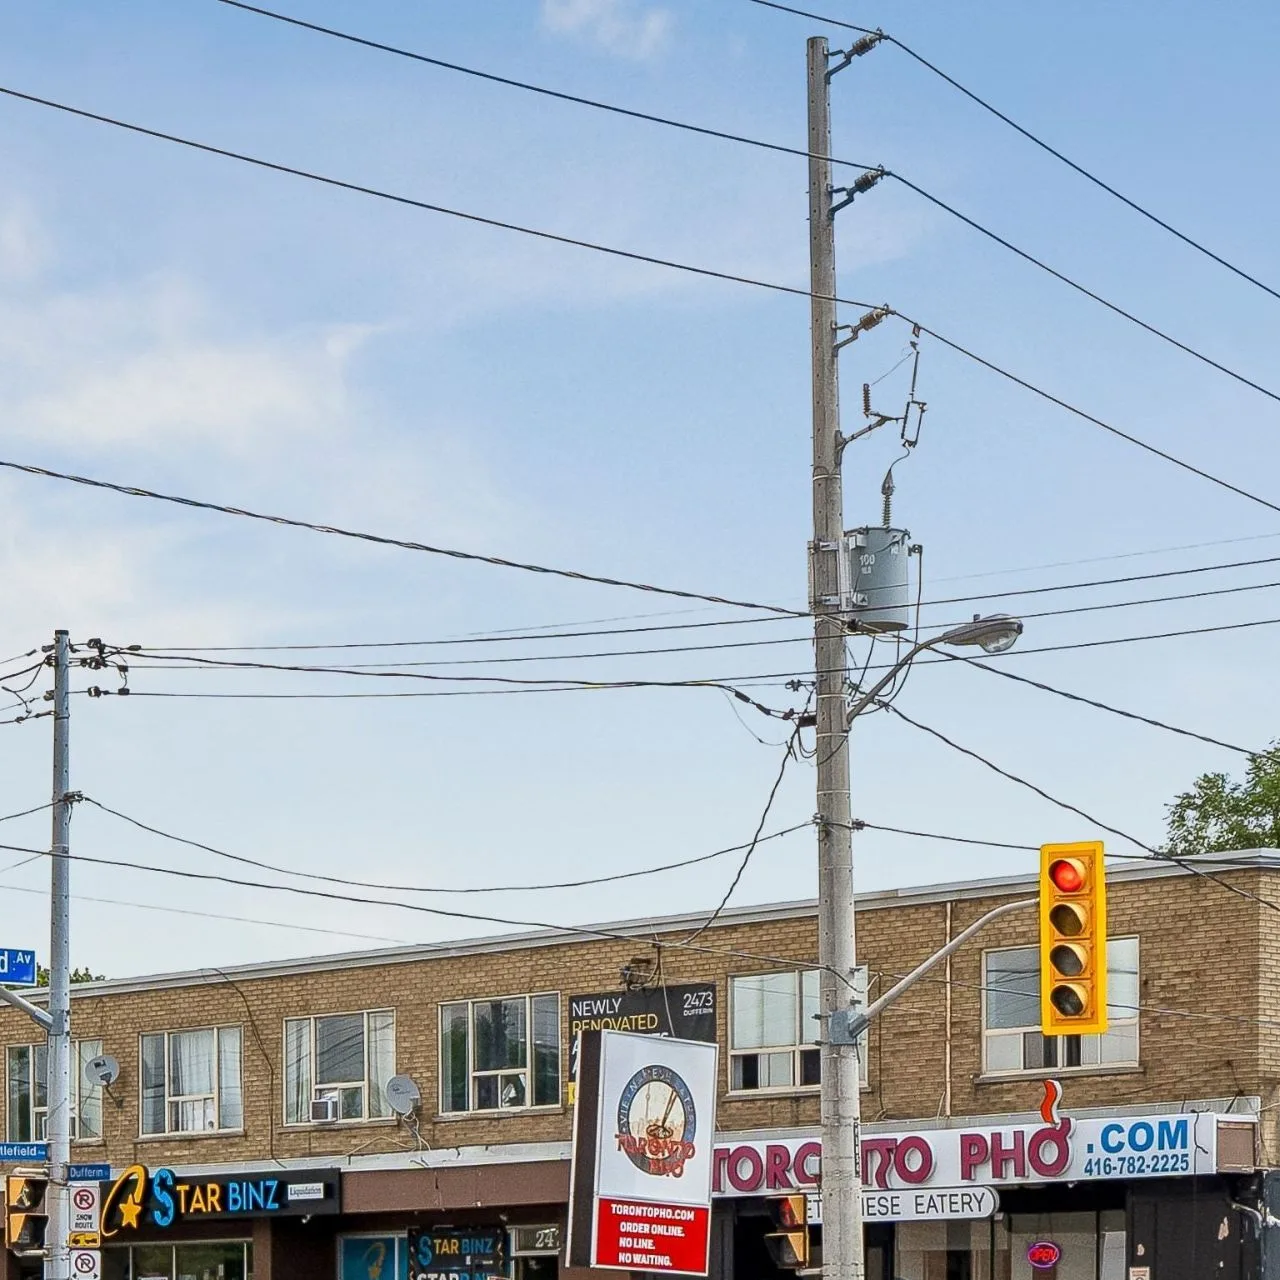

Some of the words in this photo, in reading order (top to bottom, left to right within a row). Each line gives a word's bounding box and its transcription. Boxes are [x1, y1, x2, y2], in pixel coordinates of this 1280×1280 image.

[16, 951, 32, 964] Av
[572, 998, 622, 1017] NEWLY
[683, 991, 714, 1009] 2473
[683, 1007, 714, 1017] DUFFERIN
[1086, 1119, 1188, 1154] .COM
[70, 1167, 104, 1178] Dufferin
[712, 1136, 933, 1192] TOROTO
[1084, 1154, 1190, 1177] 416-782-2225
[153, 1168, 221, 1227] STAR
[228, 1180, 280, 1211] BINZ
[915, 1192, 986, 1215] EATERY
[610, 1203, 695, 1221] TORONTOPHO.COM
[620, 1221, 650, 1233] ORDER
[651, 1224, 686, 1237] ONLINE.
[418, 1236, 459, 1266] STAR
[461, 1238, 493, 1255] BINZ
[619, 1237, 632, 1247] NO
[633, 1238, 655, 1250] LINE.
[618, 1252, 632, 1263] NO
[632, 1253, 673, 1267] WAITING.
[1030, 1248, 1056, 1262] OPEN
